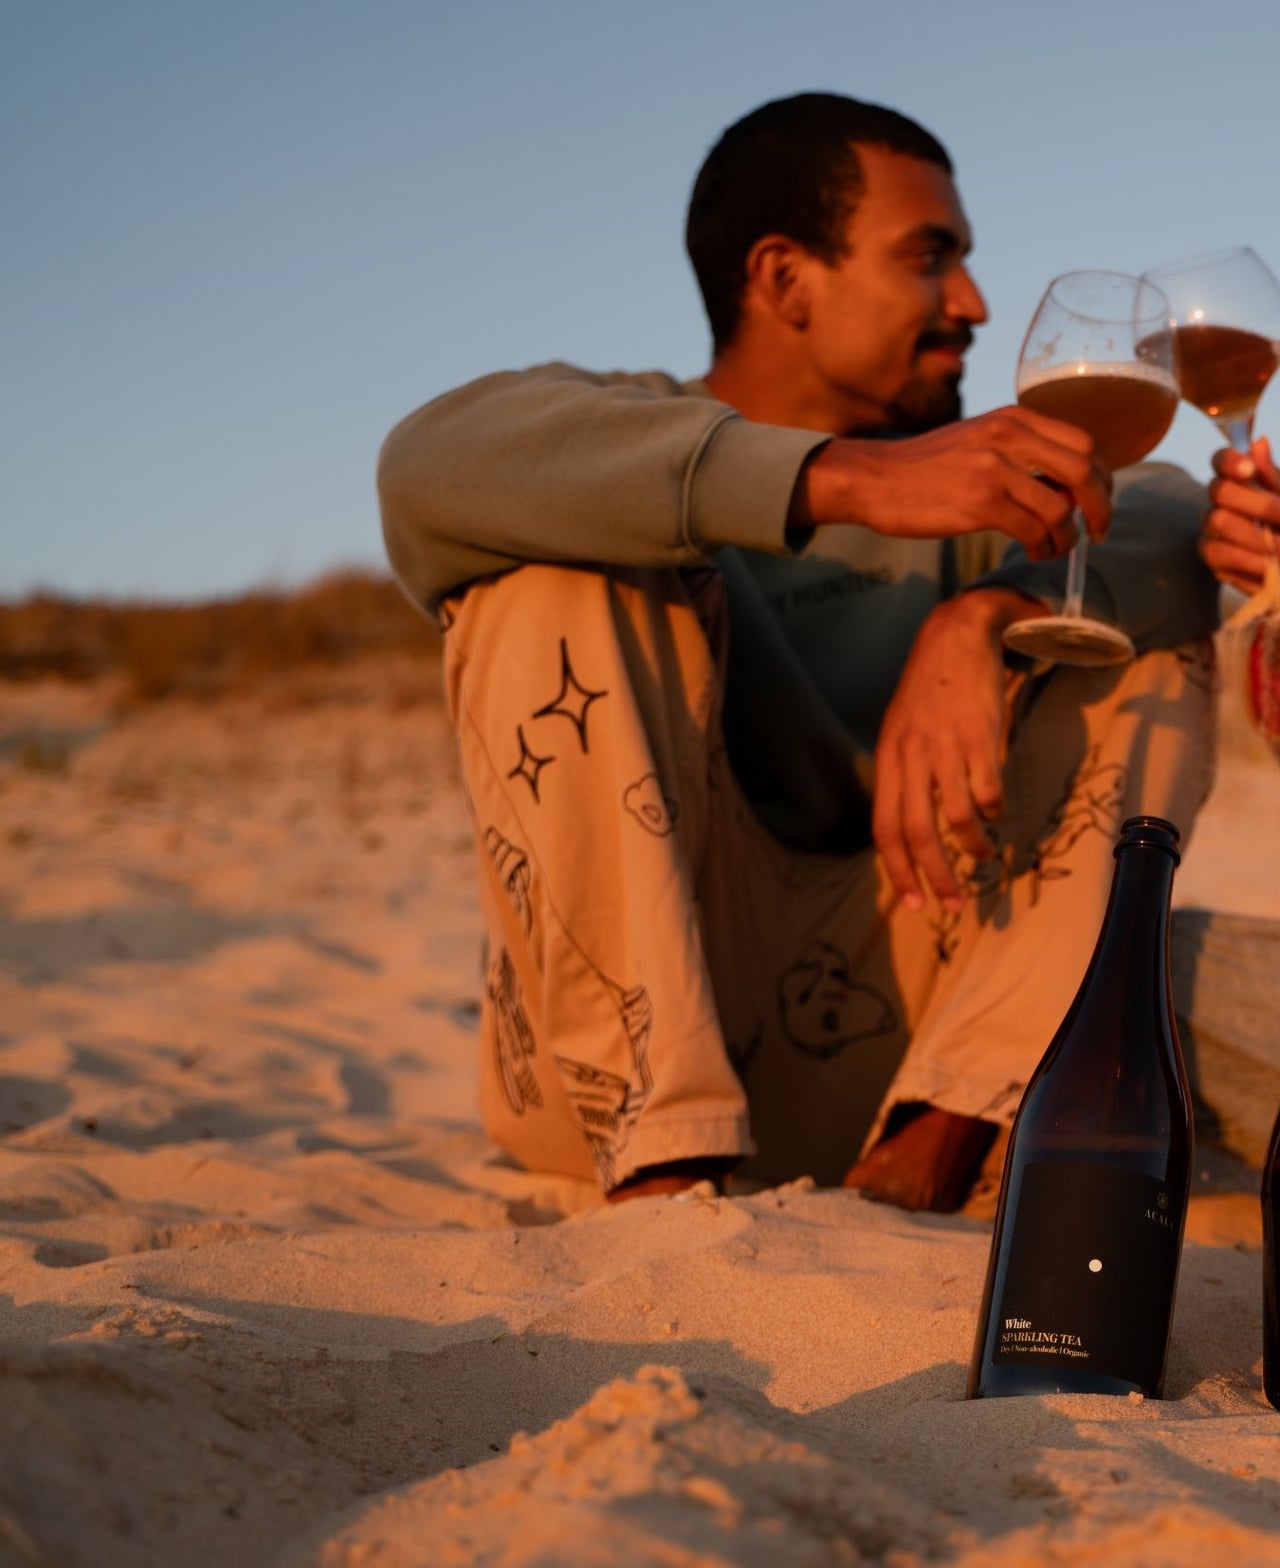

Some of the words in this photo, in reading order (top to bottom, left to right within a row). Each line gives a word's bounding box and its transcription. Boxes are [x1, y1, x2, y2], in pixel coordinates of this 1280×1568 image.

[1005, 1318, 1032, 1330] White
[1002, 1331, 1058, 1344] SPARKLING
[1060, 1333, 1082, 1346] TEA
